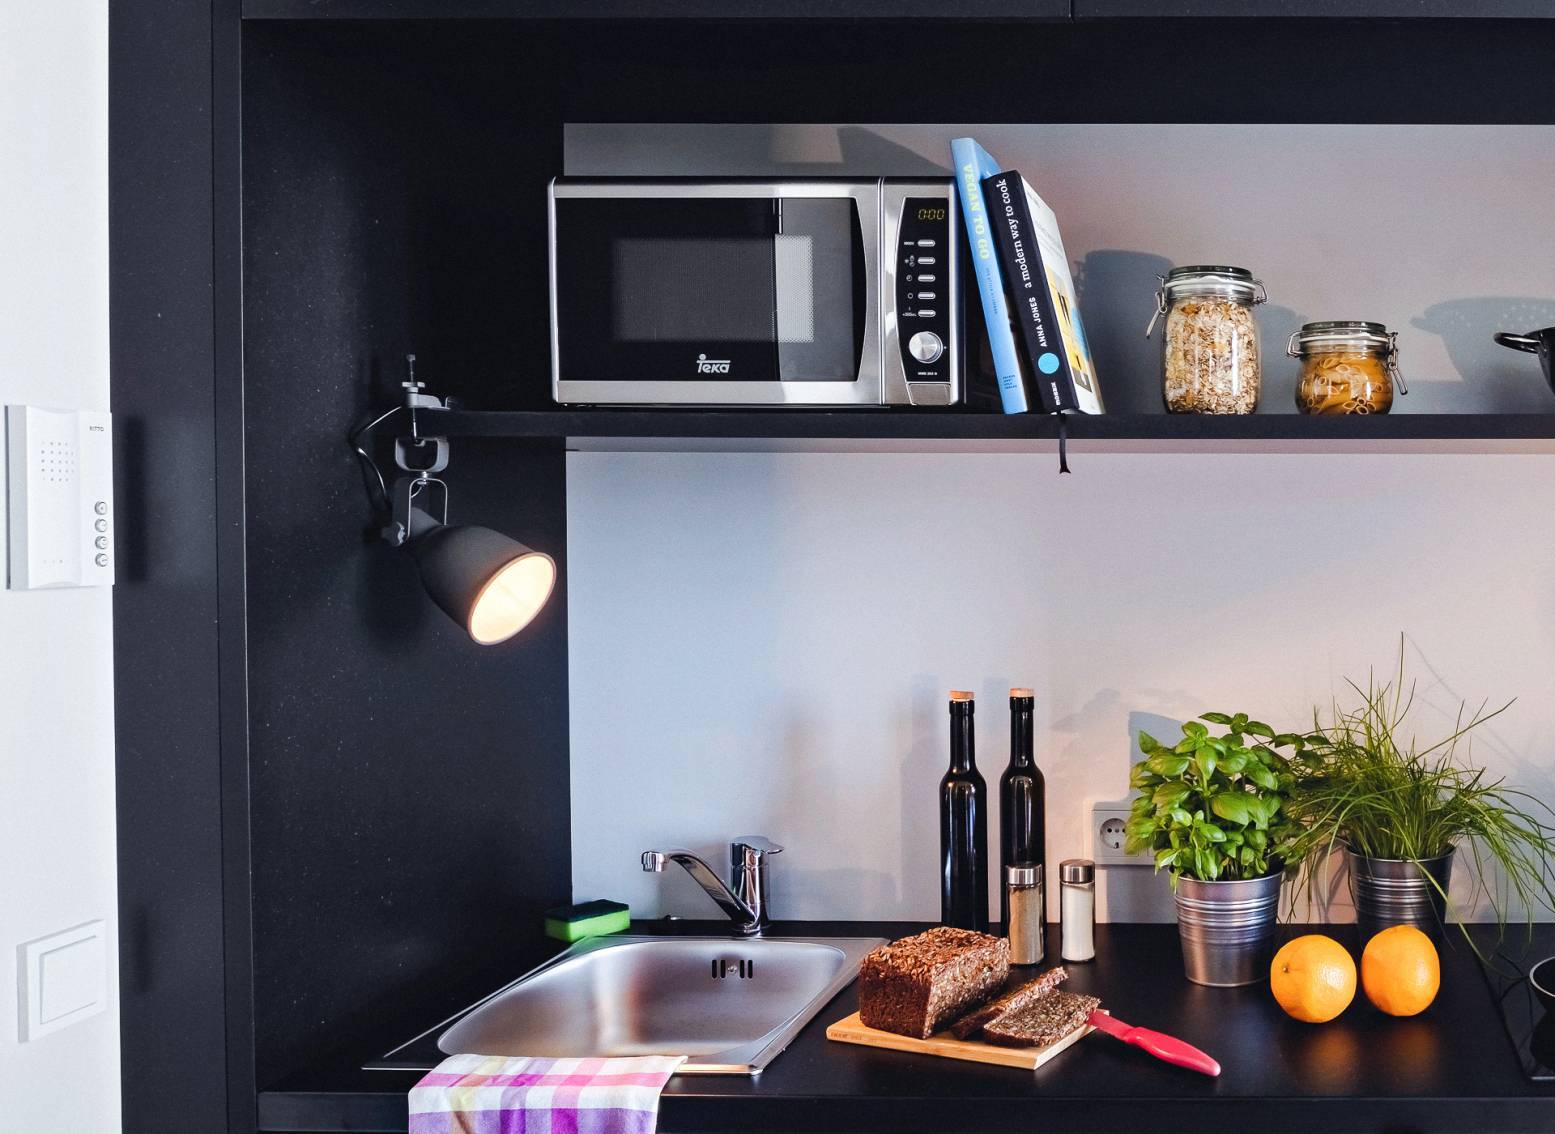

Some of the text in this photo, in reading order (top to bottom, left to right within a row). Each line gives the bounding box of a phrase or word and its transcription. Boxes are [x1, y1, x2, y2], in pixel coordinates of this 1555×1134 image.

[996, 178, 1010, 204] cook
[918, 208, 945, 220] 0:00
[962, 164, 990, 259] VEGAN TO GO
[1005, 205, 1014, 217] to
[1008, 218, 1020, 240] way
[1014, 240, 1031, 280] modern
[1029, 297, 1048, 348] ANNA JONES
